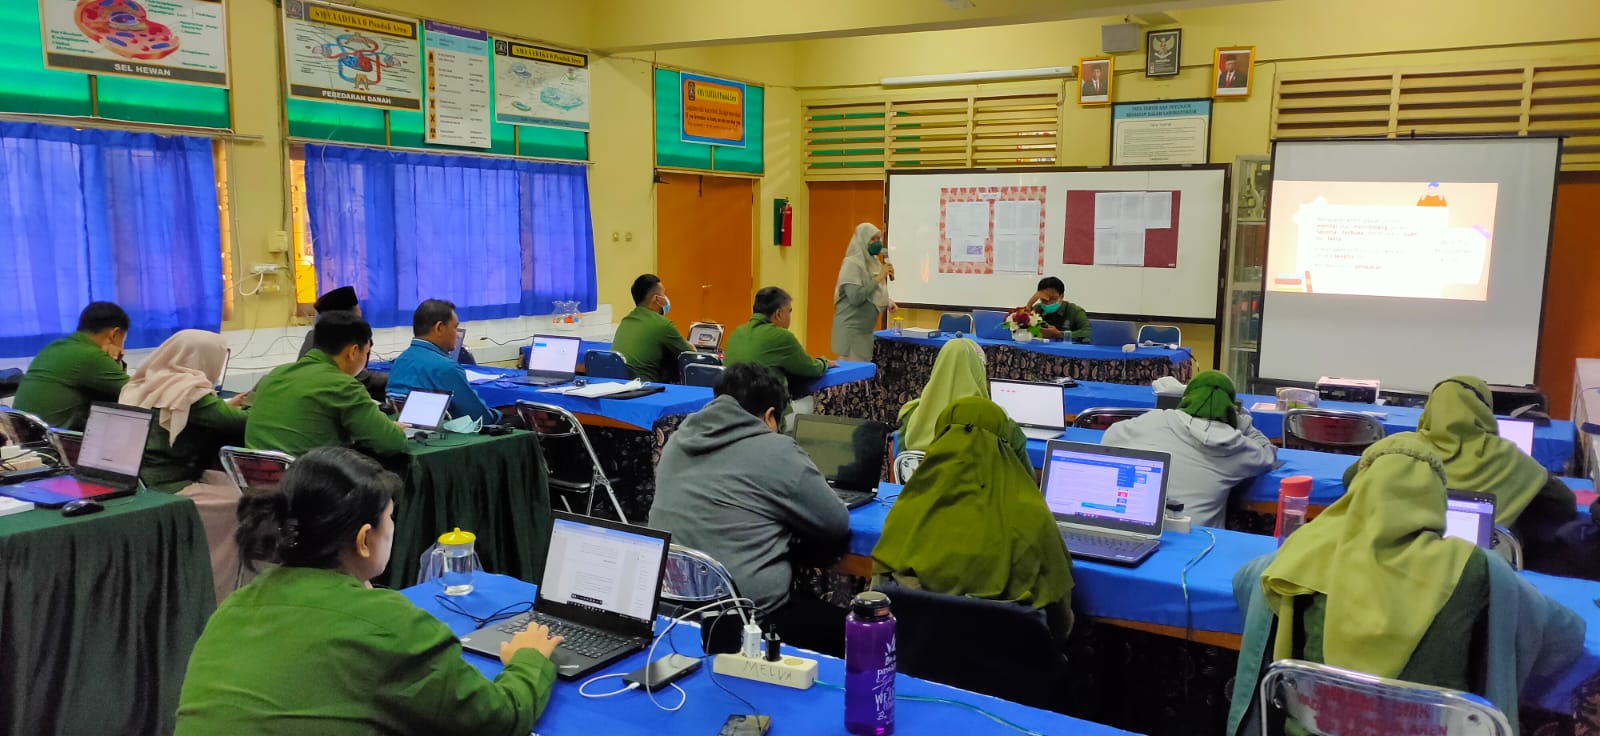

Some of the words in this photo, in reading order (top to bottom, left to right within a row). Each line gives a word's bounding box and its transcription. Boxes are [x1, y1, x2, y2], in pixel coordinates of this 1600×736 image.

[114, 63, 133, 73] SEL
[135, 65, 171, 76] HEWAN
[743, 660, 793, 681] MELVA
